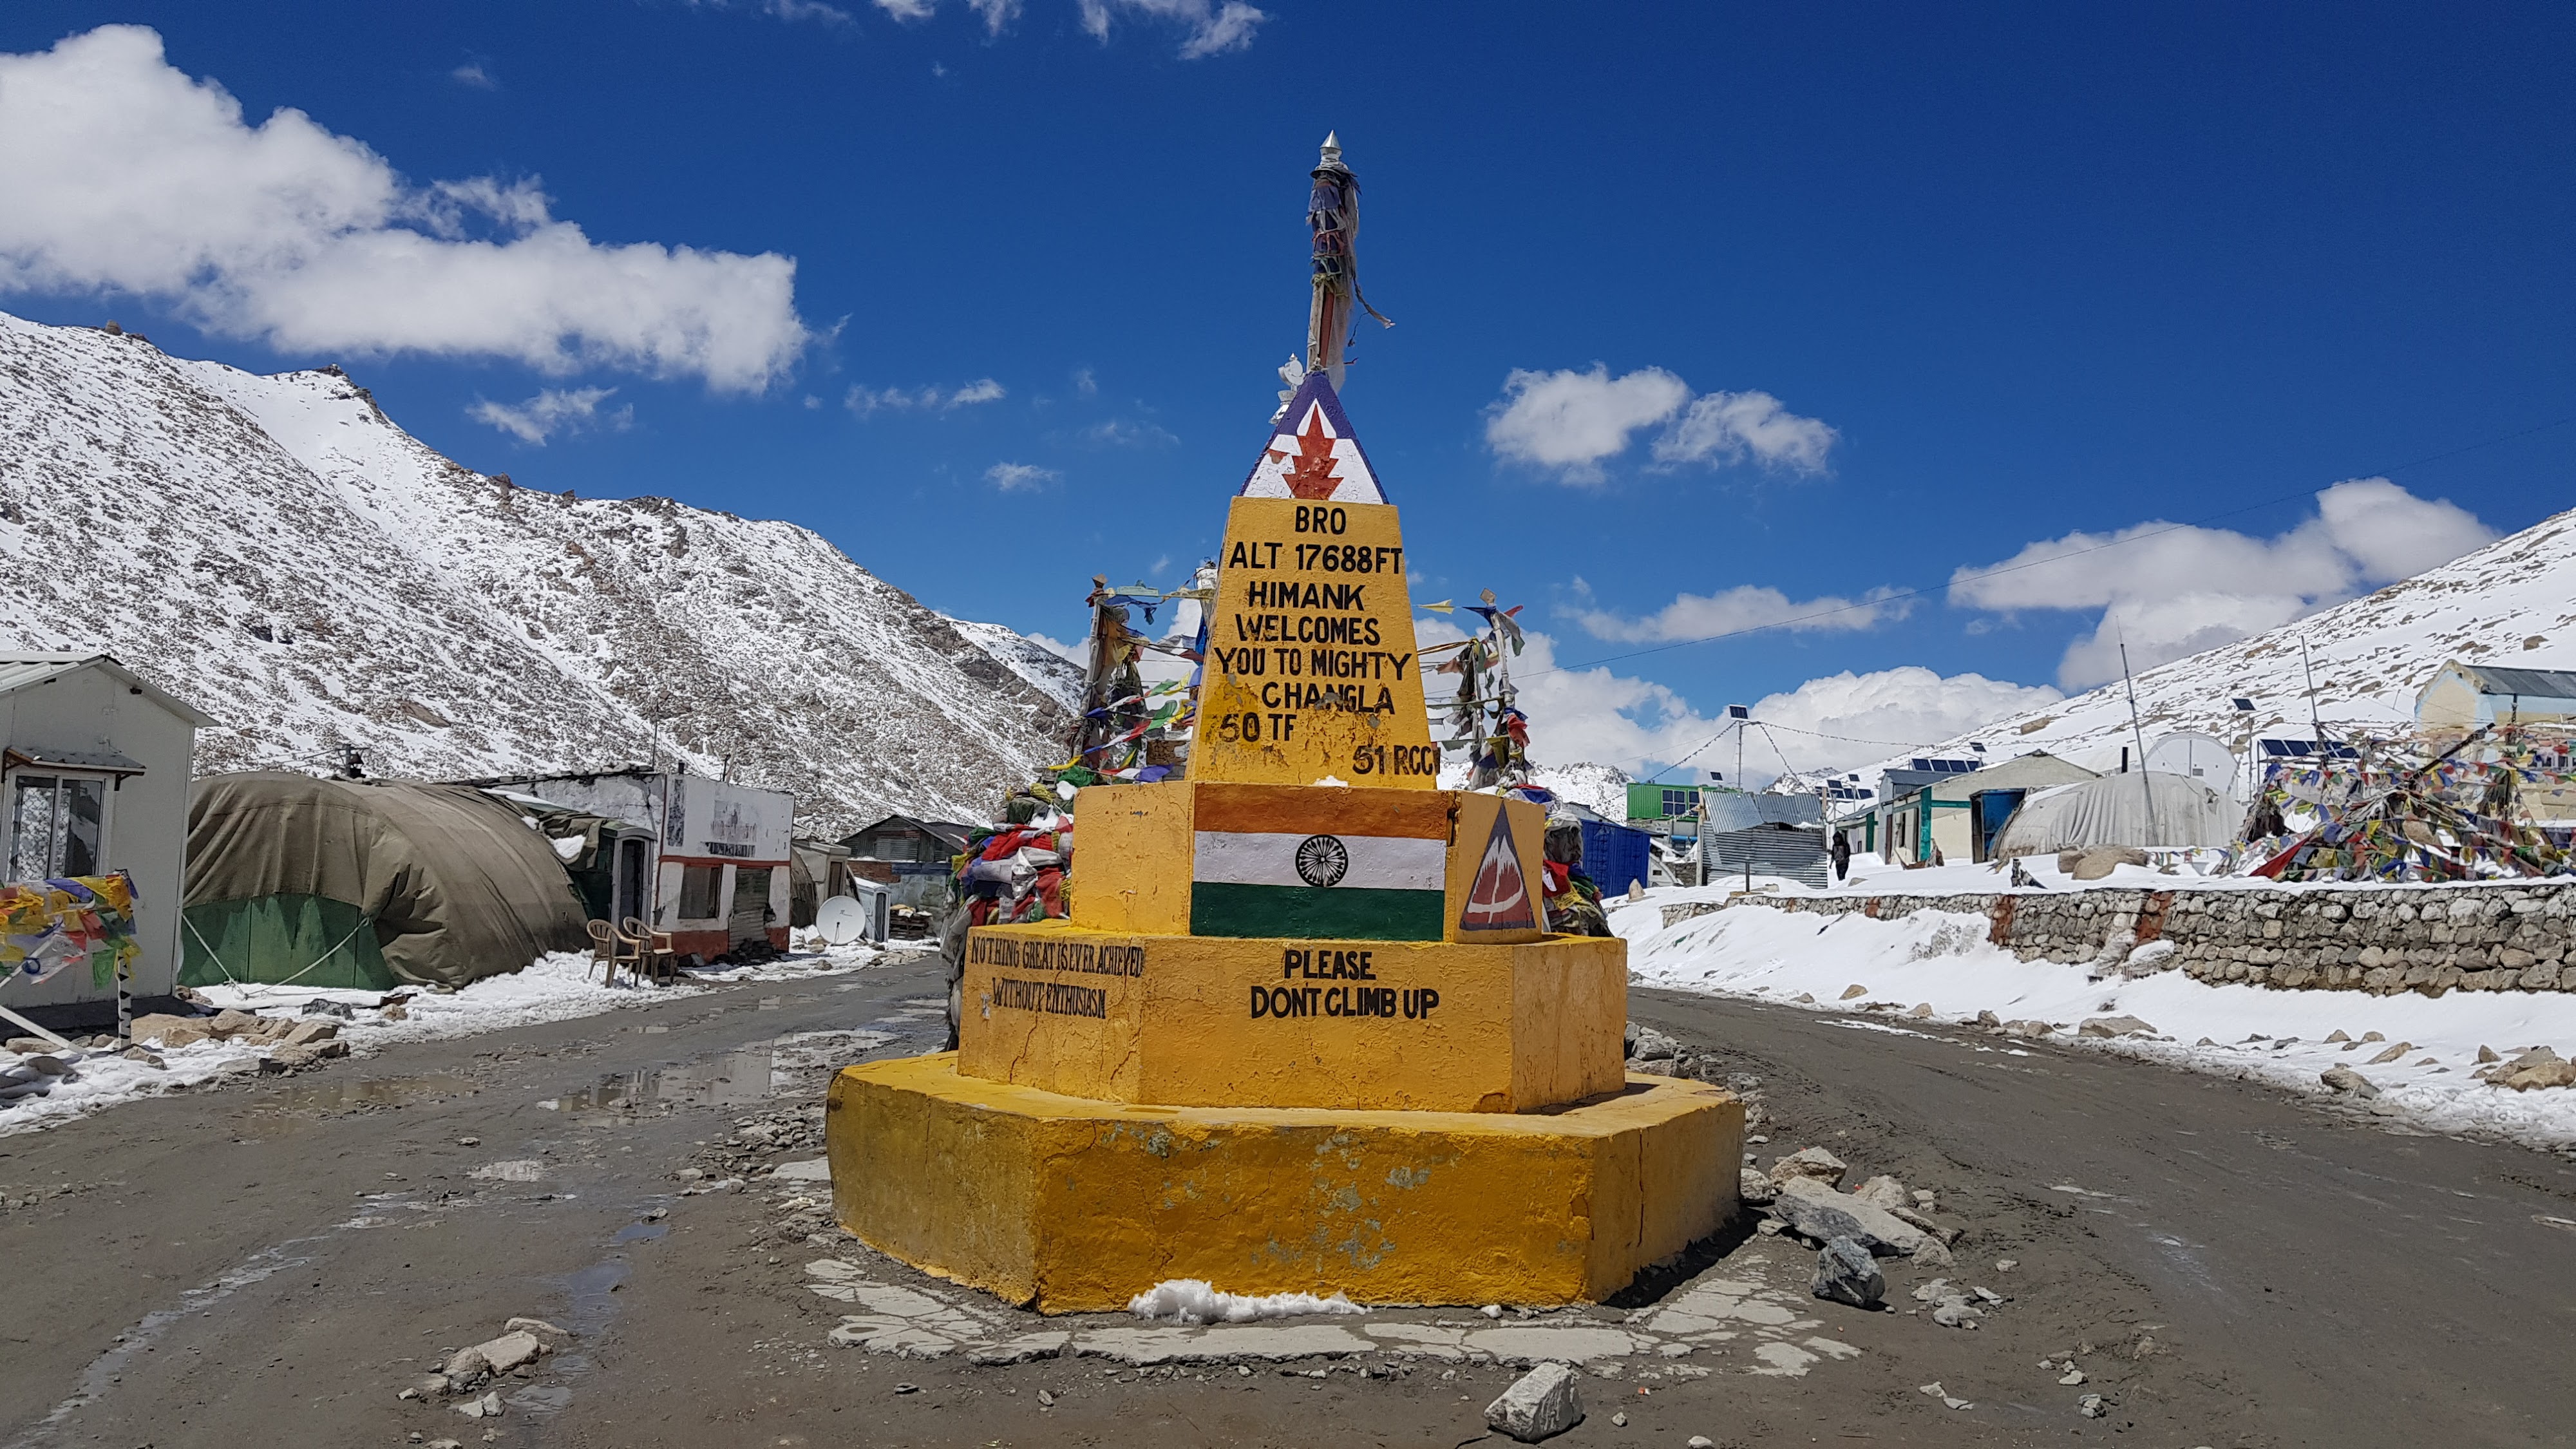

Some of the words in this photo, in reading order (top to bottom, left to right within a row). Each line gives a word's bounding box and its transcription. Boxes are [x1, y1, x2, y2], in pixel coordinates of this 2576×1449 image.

[1295, 506, 1346, 535] BRO
[1229, 542, 1283, 569] ALT
[1249, 582, 1365, 611] HIMANK
[1235, 614, 1381, 645] WELCOMES
[1214, 647, 1265, 676] YOU
[1274, 648, 1301, 676] TO
[1311, 650, 1412, 681] MIGHTY
[1262, 681, 1396, 715] CHANGLA
[1267, 713, 1297, 741] TF
[1352, 745, 1385, 775] 51
[971, 936, 1019, 969] NOTHING
[1022, 942, 1056, 971] GREAT
[1057, 942, 1068, 971] IS
[1069, 943, 1095, 974] EVER
[1096, 945, 1145, 978] ACHIEVED
[1284, 949, 1377, 980] PLEASE
[992, 977, 1045, 1012] WITHOUT
[1045, 982, 1106, 1019] ENTHUSIASM
[1325, 986, 1397, 1018] CLIMB
[1403, 988, 1439, 1019] UP
